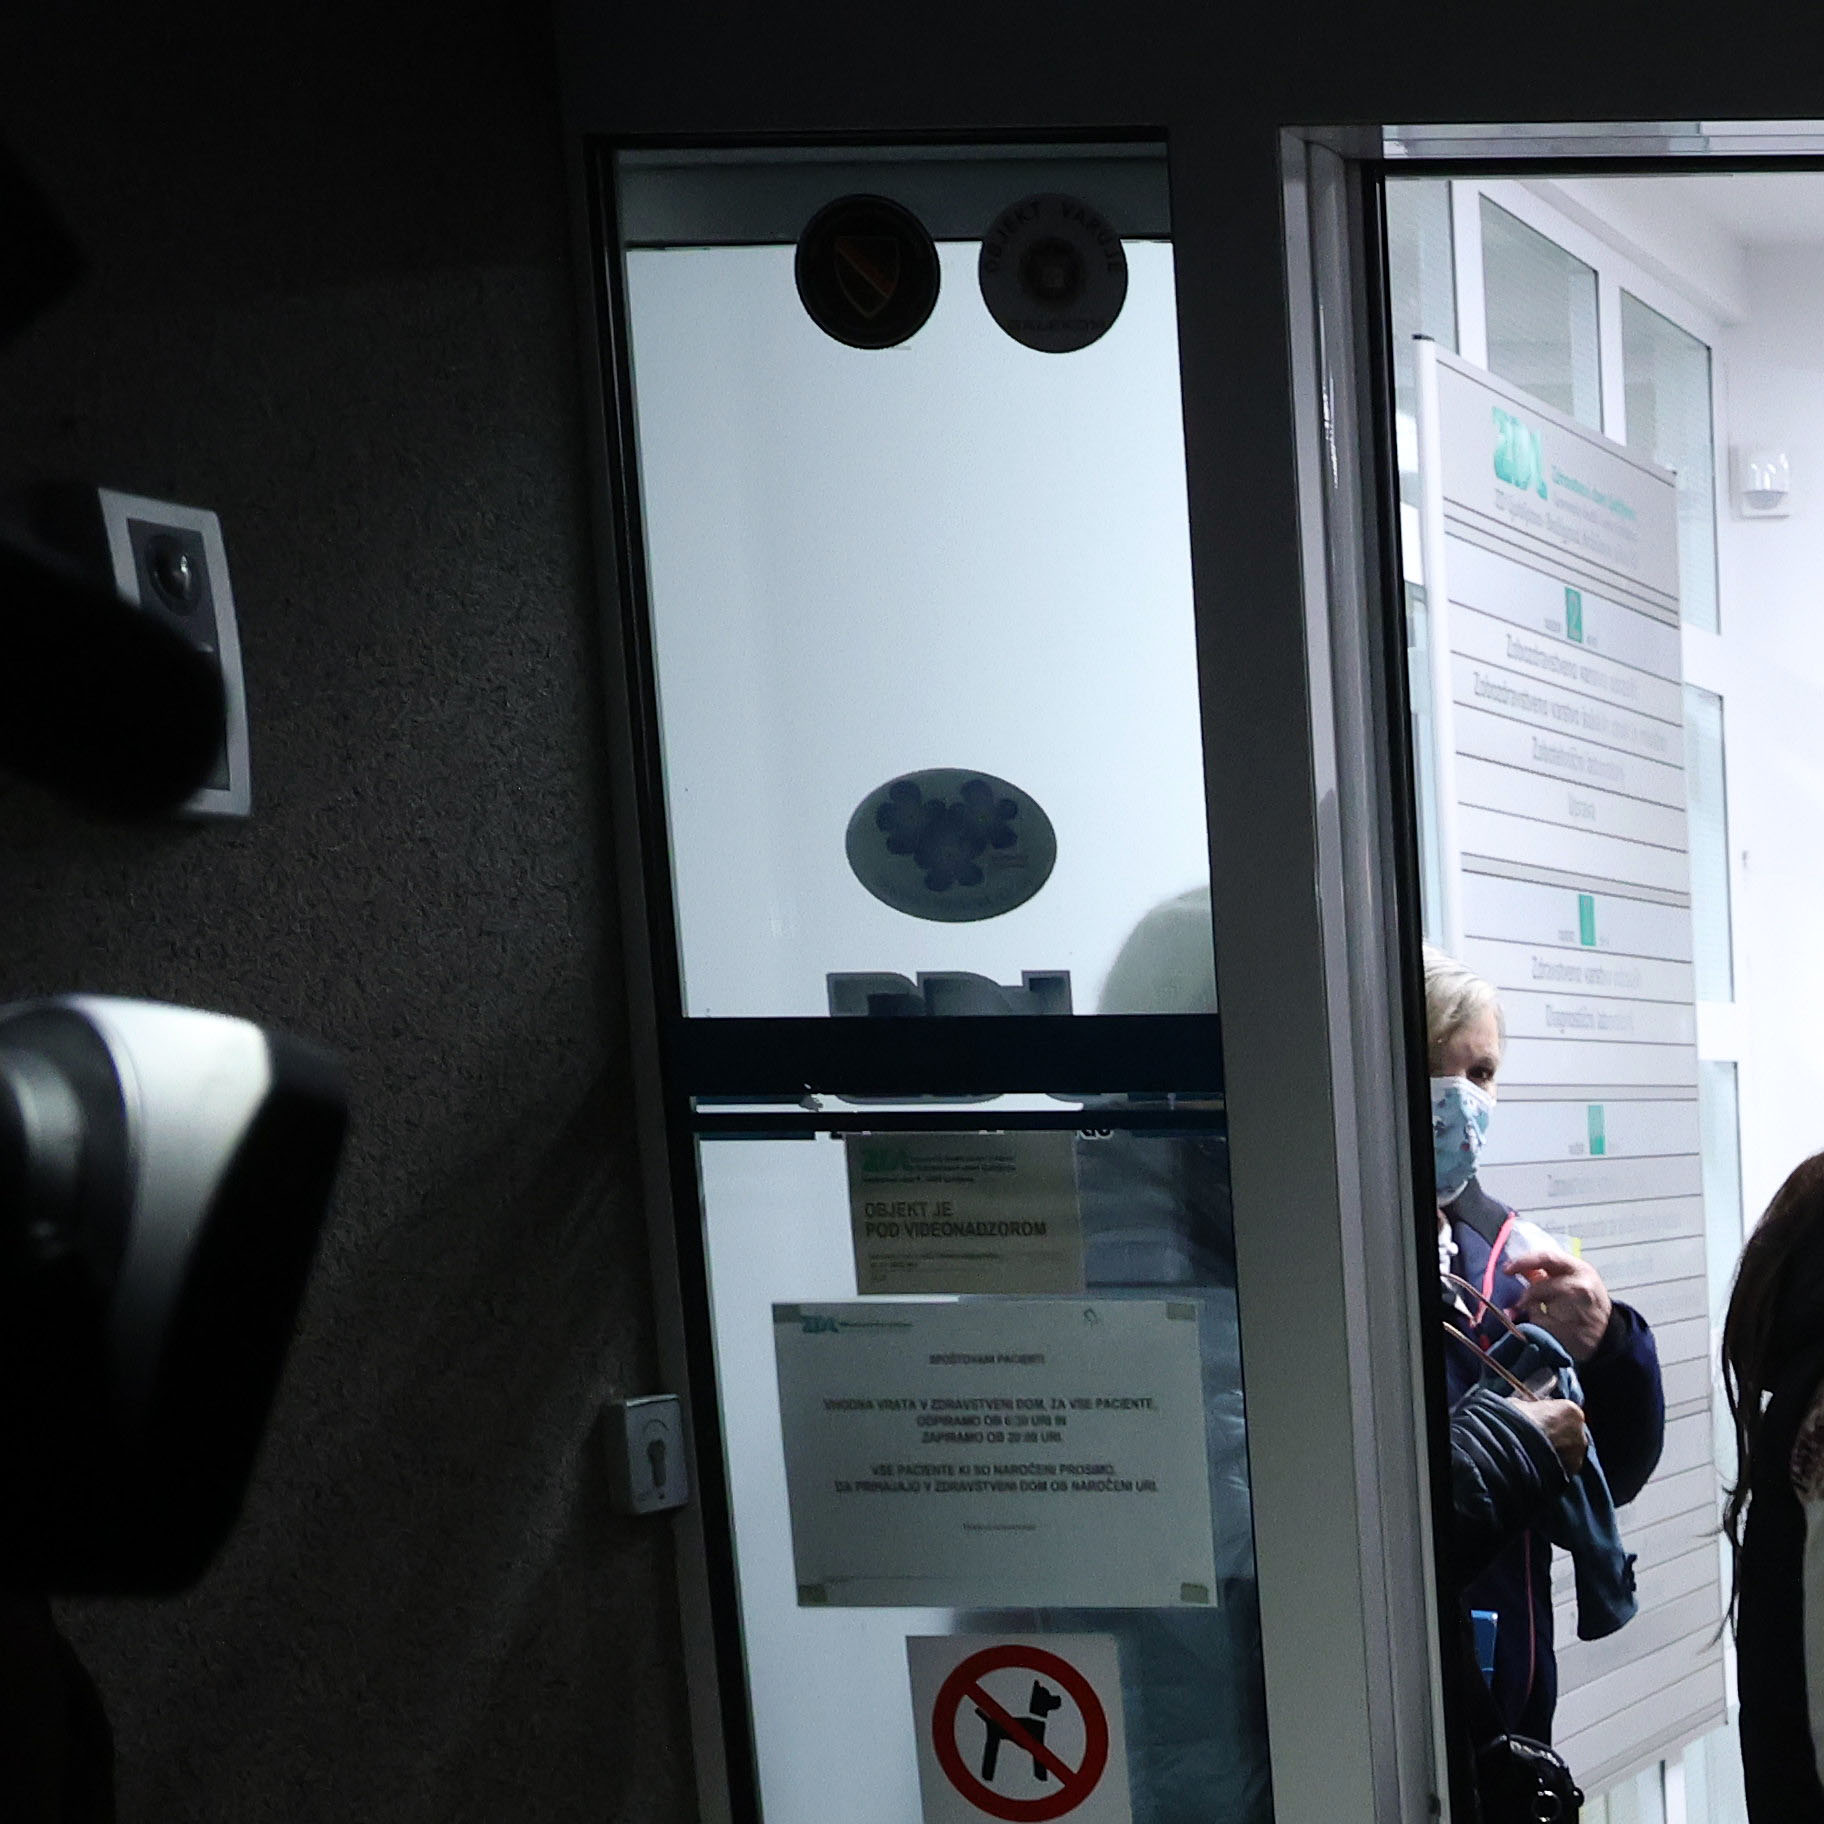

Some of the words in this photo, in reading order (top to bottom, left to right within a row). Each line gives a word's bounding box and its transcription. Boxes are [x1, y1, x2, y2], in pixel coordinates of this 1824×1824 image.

[865, 1202, 928, 1219] OBJEKT
[933, 1201, 954, 1218] JE
[865, 1221, 900, 1238] POD
[903, 1221, 1047, 1238] VIDEONADZOROM
